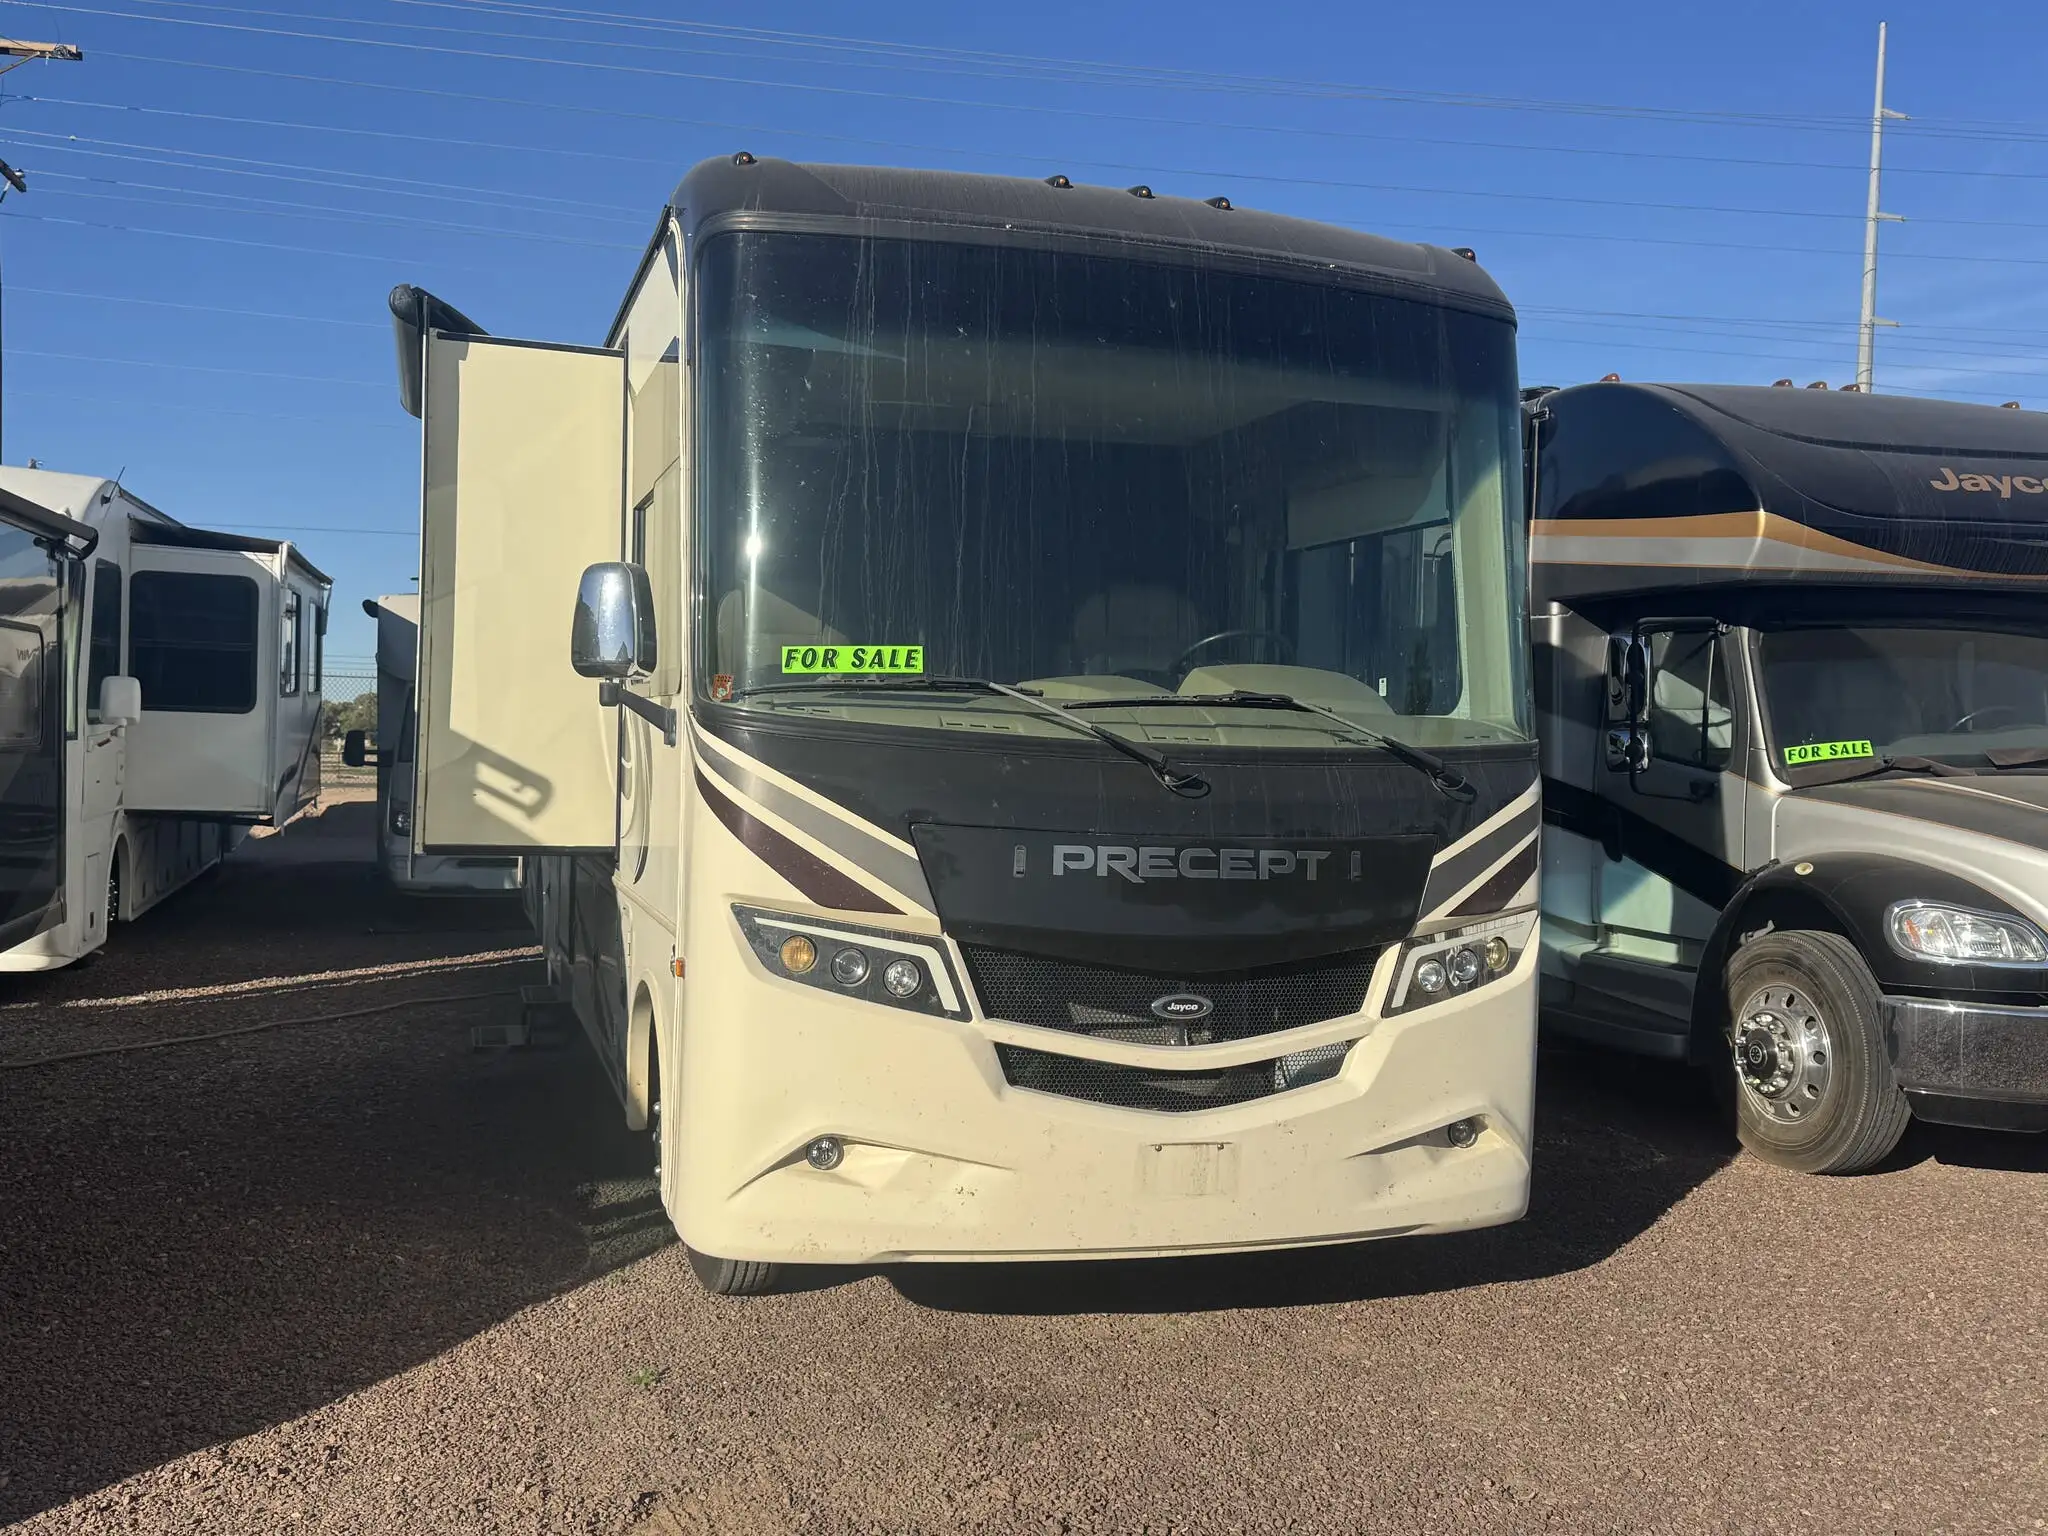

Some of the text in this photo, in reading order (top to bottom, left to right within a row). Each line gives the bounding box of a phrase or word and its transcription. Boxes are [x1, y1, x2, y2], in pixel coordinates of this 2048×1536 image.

[1929, 467, 2048, 498] Jayc
[784, 648, 918, 669] FOR SALE
[1787, 742, 1870, 761] FOR SALE
[1053, 845, 1331, 883] PRECEPT
[1167, 1002, 1199, 1012] Jayco
